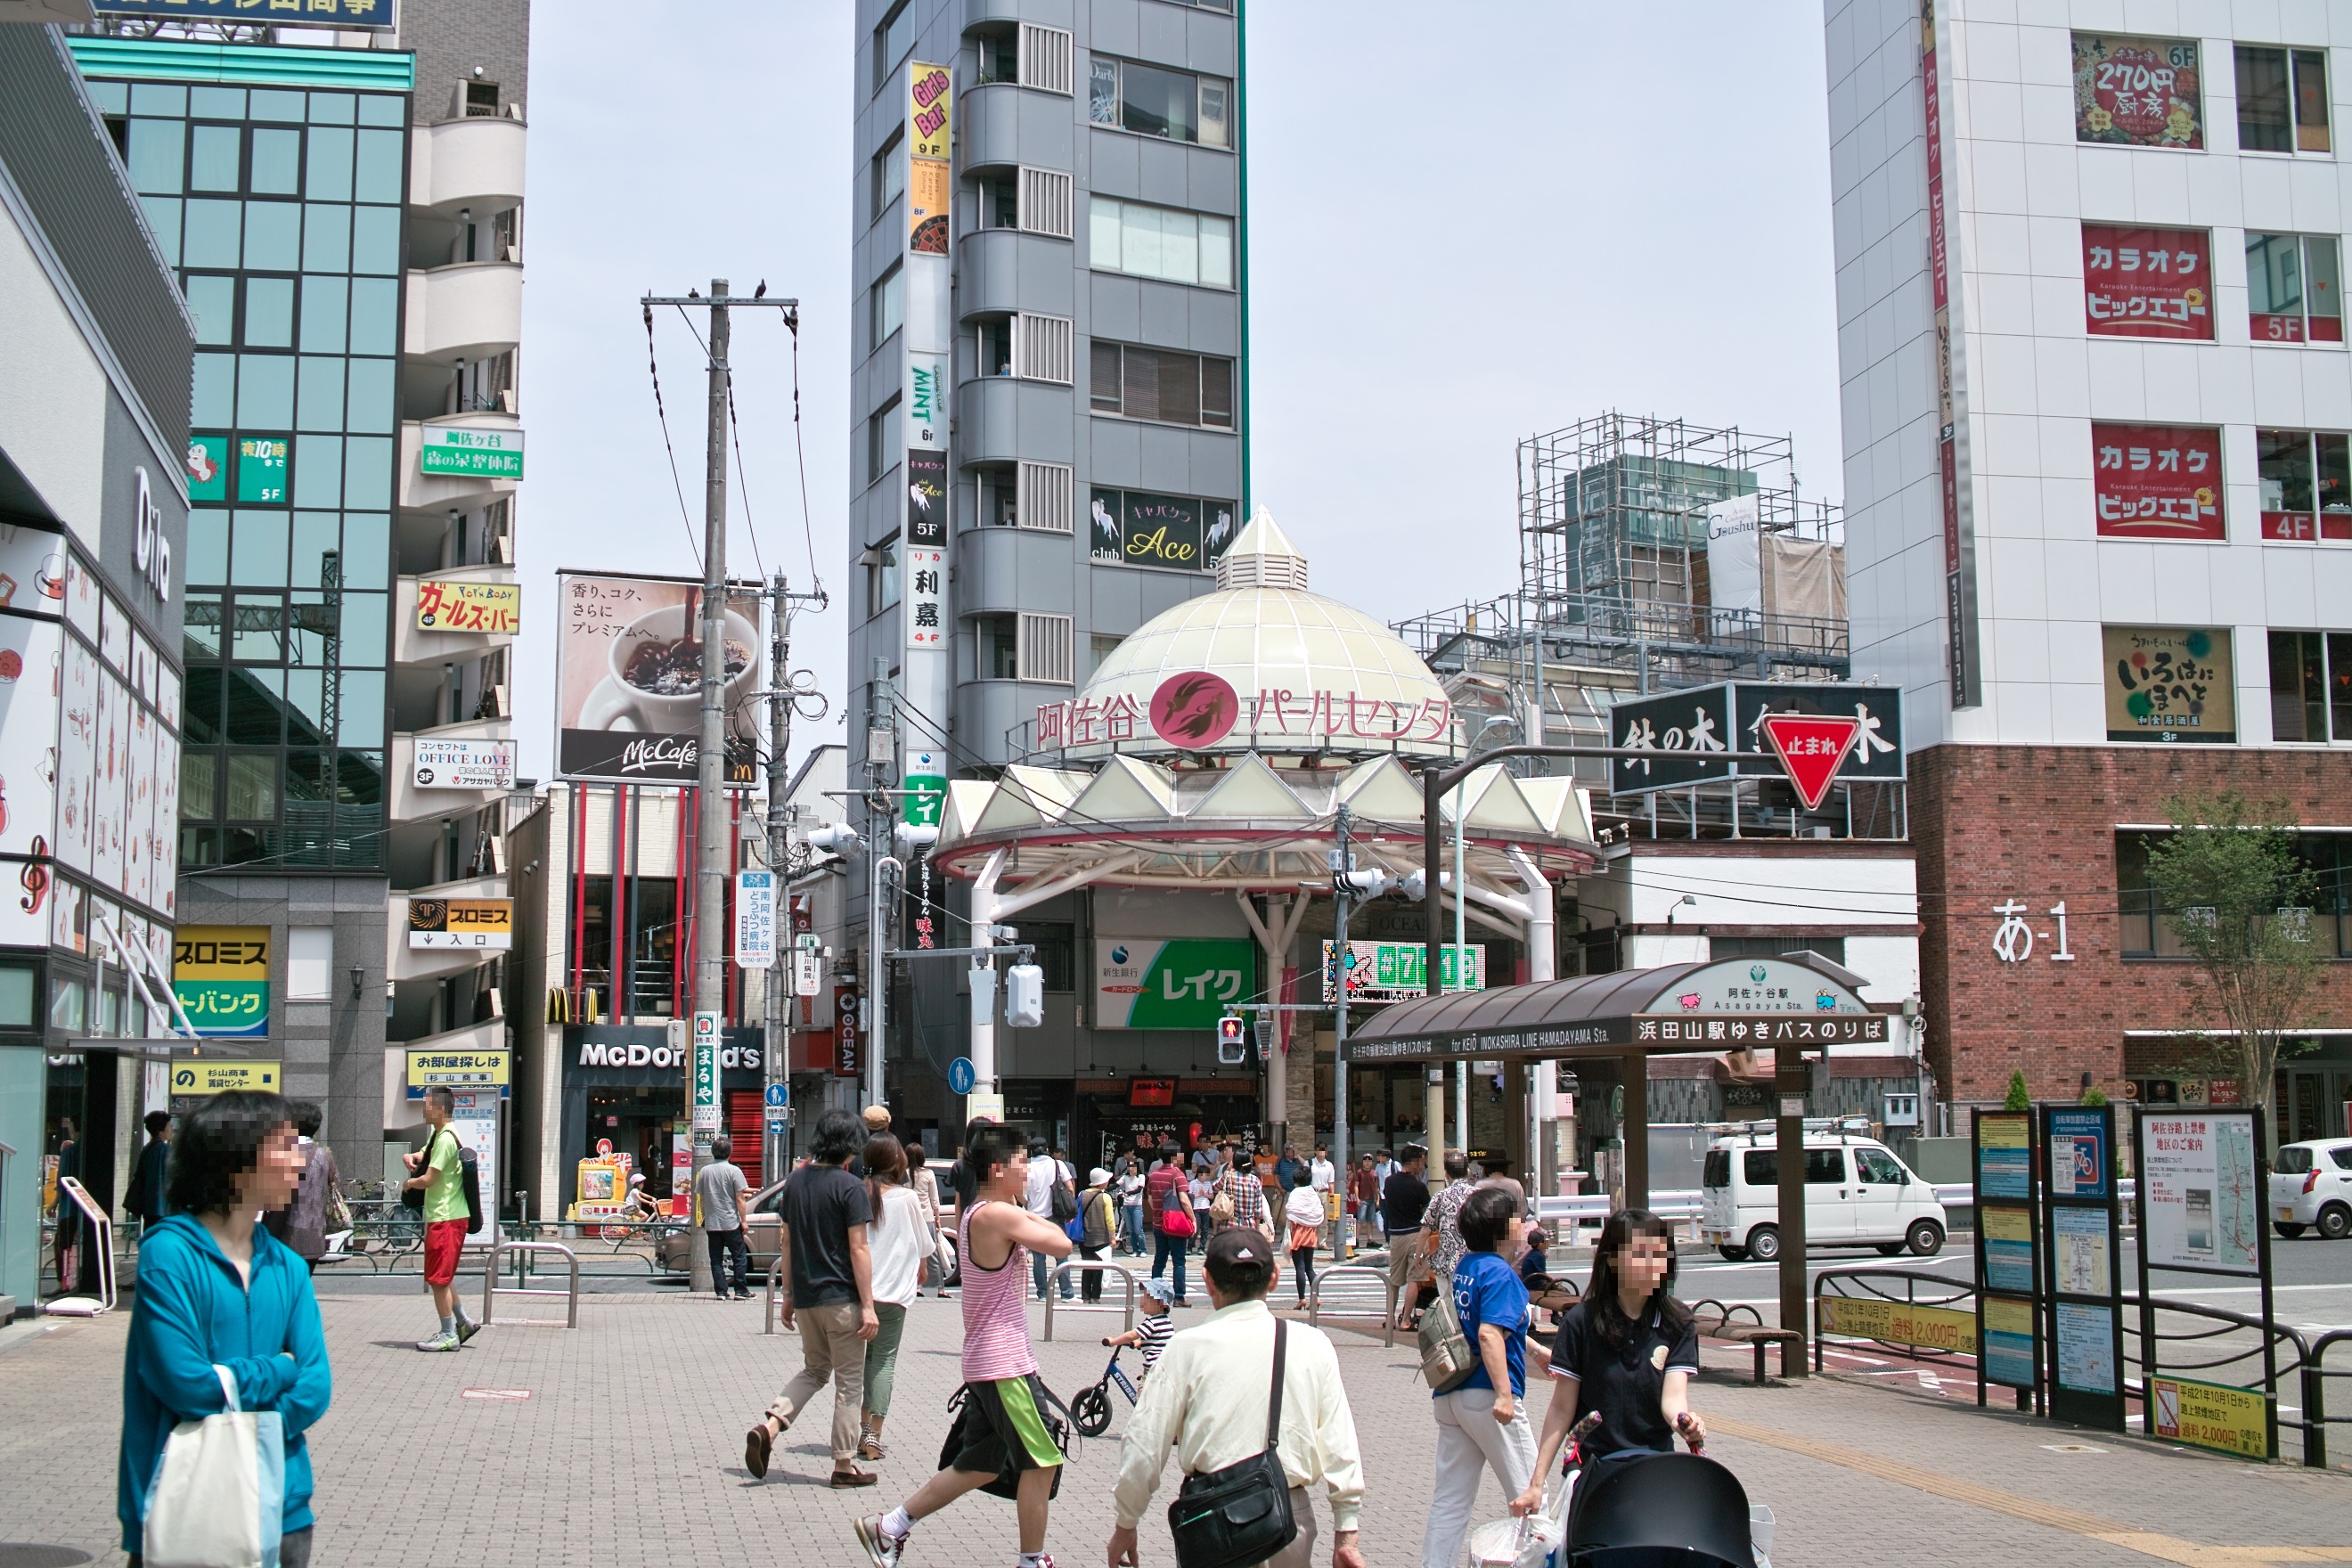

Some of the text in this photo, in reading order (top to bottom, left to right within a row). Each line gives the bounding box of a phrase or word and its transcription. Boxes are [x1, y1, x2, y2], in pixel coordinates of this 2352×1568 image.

[2168, 46, 2193, 68] 6F
[1090, 63, 1115, 81] Darts
[2096, 62, 2175, 94] 270円
[912, 70, 950, 108] Girls
[2113, 91, 2164, 118] 厨房
[914, 102, 946, 139] Bar
[1926, 69, 1940, 163] カラオケ
[914, 208, 925, 216] 8F
[2089, 246, 2198, 274] カラオケ
[2100, 282, 2181, 292] Karaoke Entertainment
[2087, 292, 2206, 322] ビッグエコー
[2268, 316, 2299, 340] 5F
[911, 365, 934, 424] MINT
[922, 429, 933, 441] 6F
[1945, 426, 1952, 436] 3F
[241, 439, 286, 459] 夜10時
[265, 460, 283, 468] まで
[426, 451, 519, 471] 森の泉整体院
[910, 461, 945, 470] キャバクラ
[2100, 445, 2209, 473] カラオケ
[261, 489, 281, 501] 5F
[919, 485, 944, 496] Ace
[1133, 505, 1191, 523] キャバクラ
[2098, 493, 2216, 522] ビッグエコー
[134, 465, 170, 602] Dila
[917, 523, 938, 535] 5F
[2276, 516, 2309, 538] 4F
[1126, 526, 1196, 560] Ace
[1092, 546, 1120, 560] club
[572, 584, 642, 602] 香り、コク、
[915, 569, 939, 627] 利嘉
[573, 603, 613, 618] さらに
[423, 616, 434, 625] 4F
[572, 622, 660, 641] プレミアムへ。
[2118, 652, 2214, 690] いろはに
[2144, 682, 2208, 711] ほへと
[1036, 692, 1143, 751] 阿佐谷
[1250, 689, 1466, 743] パールセンター
[2138, 715, 2200, 726] 和食居酒屋
[1786, 736, 1839, 755] 止まれ
[2162, 731, 2177, 741] 3F
[421, 742, 467, 751] コンセプトは
[419, 753, 510, 765] OFFICE LOVE
[419, 772, 433, 781] 3F
[462, 777, 510, 785] アサガヤバンク
[916, 783, 936, 827] レイ
[450, 909, 508, 924] プロミス
[749, 891, 759, 951] どうぶつ病院
[451, 934, 486, 945] 入口
[916, 918, 934, 950] 味丸
[176, 941, 266, 965] プロミス
[1103, 968, 1139, 977] 新生銀行
[1163, 968, 1242, 1000] レイク
[1728, 987, 1790, 999] 阿佐ヶ谷駅
[178, 990, 260, 1014] トバンク
[1714, 1001, 1804, 1011] Asagaya Sta.
[699, 1020, 709, 1032] 質
[1638, 1021, 1882, 1040] 浜田山駅ゆきバスのりば
[842, 1013, 855, 1071] OCEAN
[1451, 1027, 1610, 1052] for KEIŌ INOKASHIRA LINE HAMADAYAMA Sta.
[417, 1056, 501, 1068] お部屋探しは
[579, 1044, 760, 1069] McDond's
[208, 1069, 249, 1077] 杉山商事
[429, 1074, 487, 1082] 杉山商事
[698, 1048, 714, 1102] まるや
[208, 1079, 250, 1087] 賃貸センター
[2152, 1122, 2206, 1135] 阿佐谷路上禁煙
[2156, 1139, 2203, 1151] 地区のご案内
[1837, 1302, 1890, 1319] 平成21年10月1日
[1891, 1318, 1914, 1340] 過料
[1916, 1321, 1958, 1346] 2,000円
[2180, 1385, 2250, 1409] 平成21年10月1日から
[2181, 1403, 2227, 1423] 路上禁煙地区で
[2182, 1422, 2199, 1440] 過料
[2201, 1425, 2237, 1447] 2,000円
